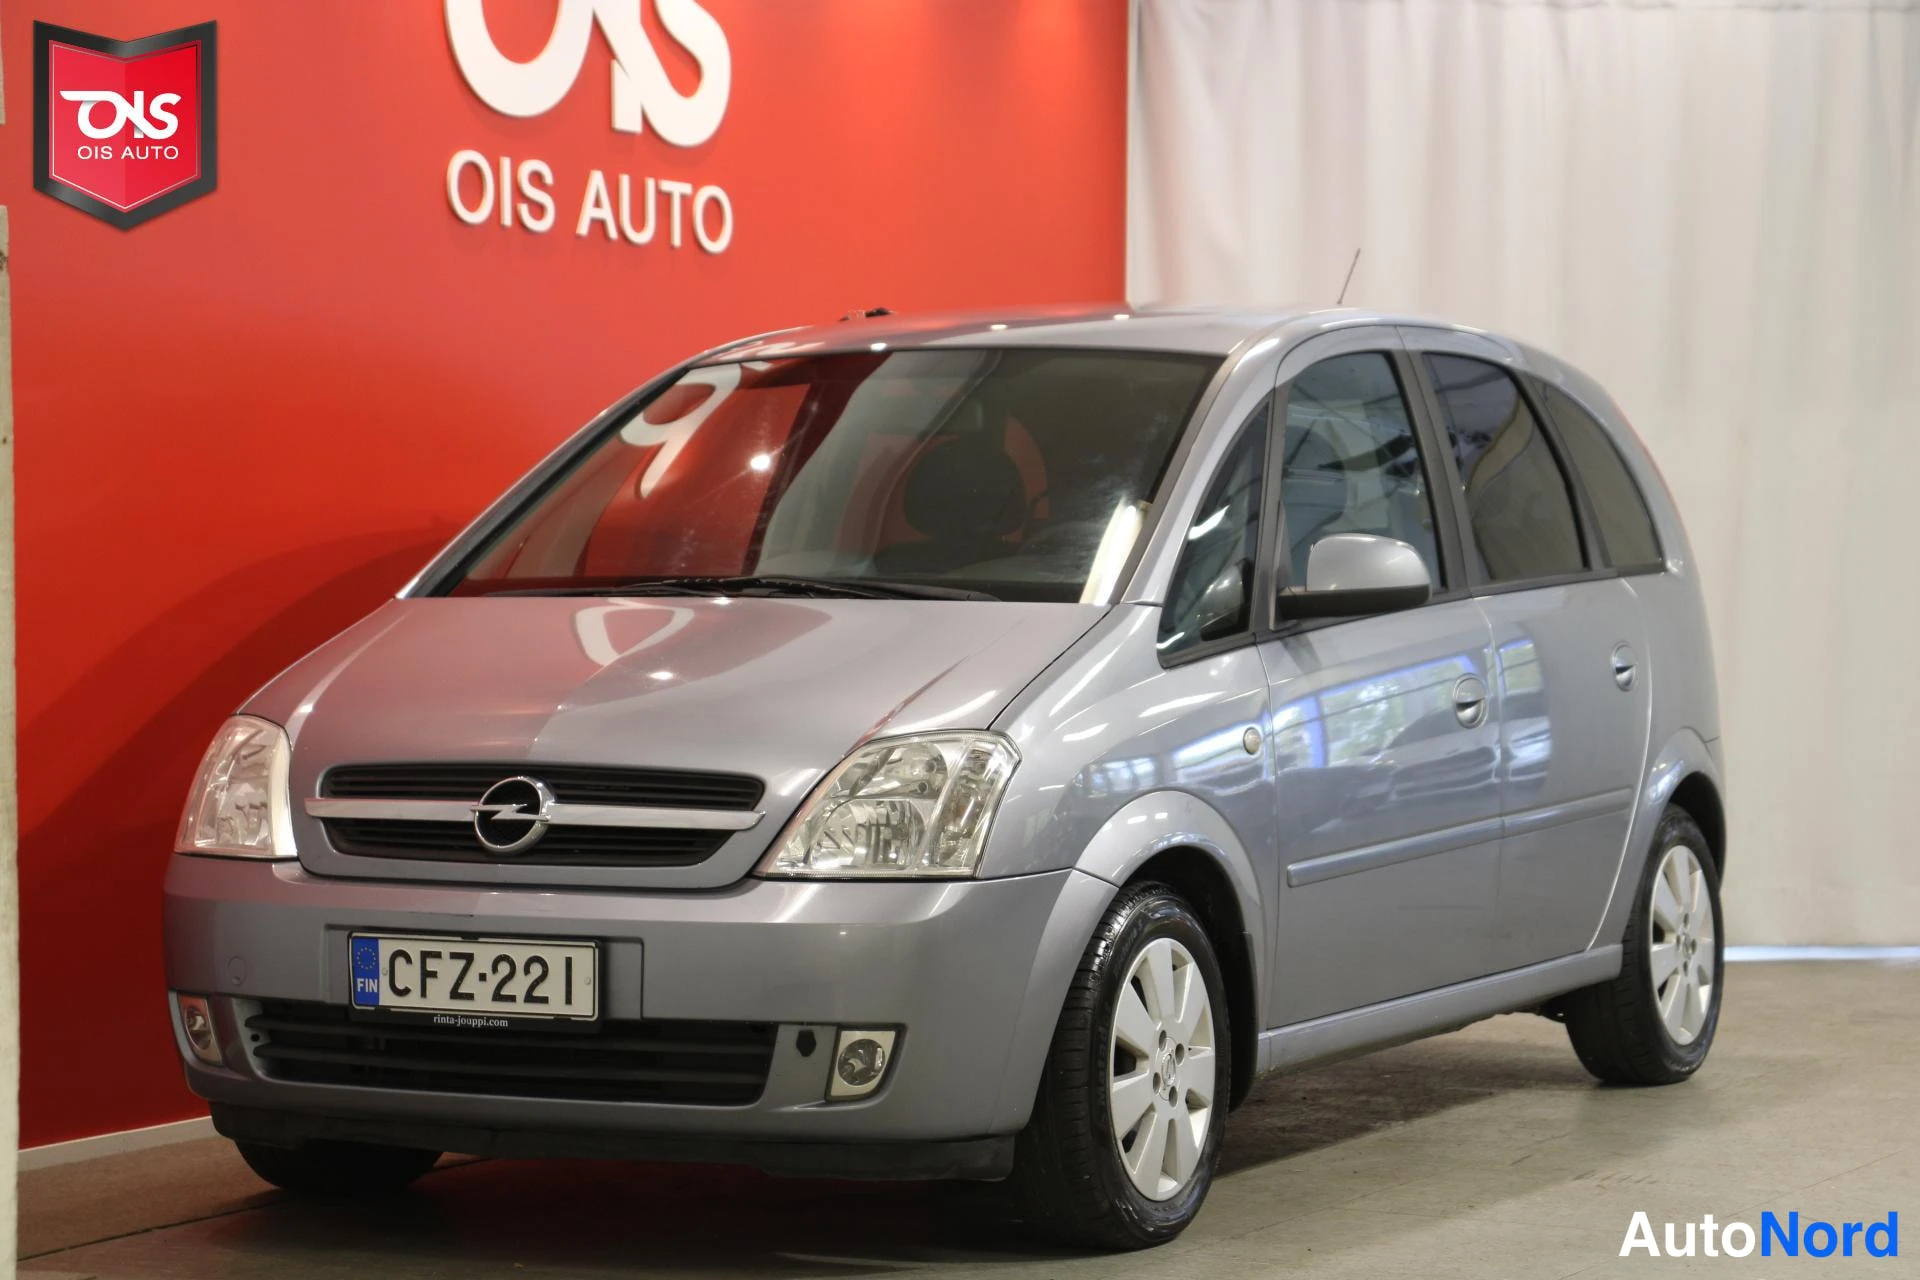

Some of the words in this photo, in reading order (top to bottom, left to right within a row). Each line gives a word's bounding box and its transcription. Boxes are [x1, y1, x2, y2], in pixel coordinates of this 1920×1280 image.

[446, 149, 556, 233] OIS
[575, 169, 733, 254] AUTO
[357, 978, 378, 993] FIN
[433, 1013, 509, 1028] rinta-jouppi.com
